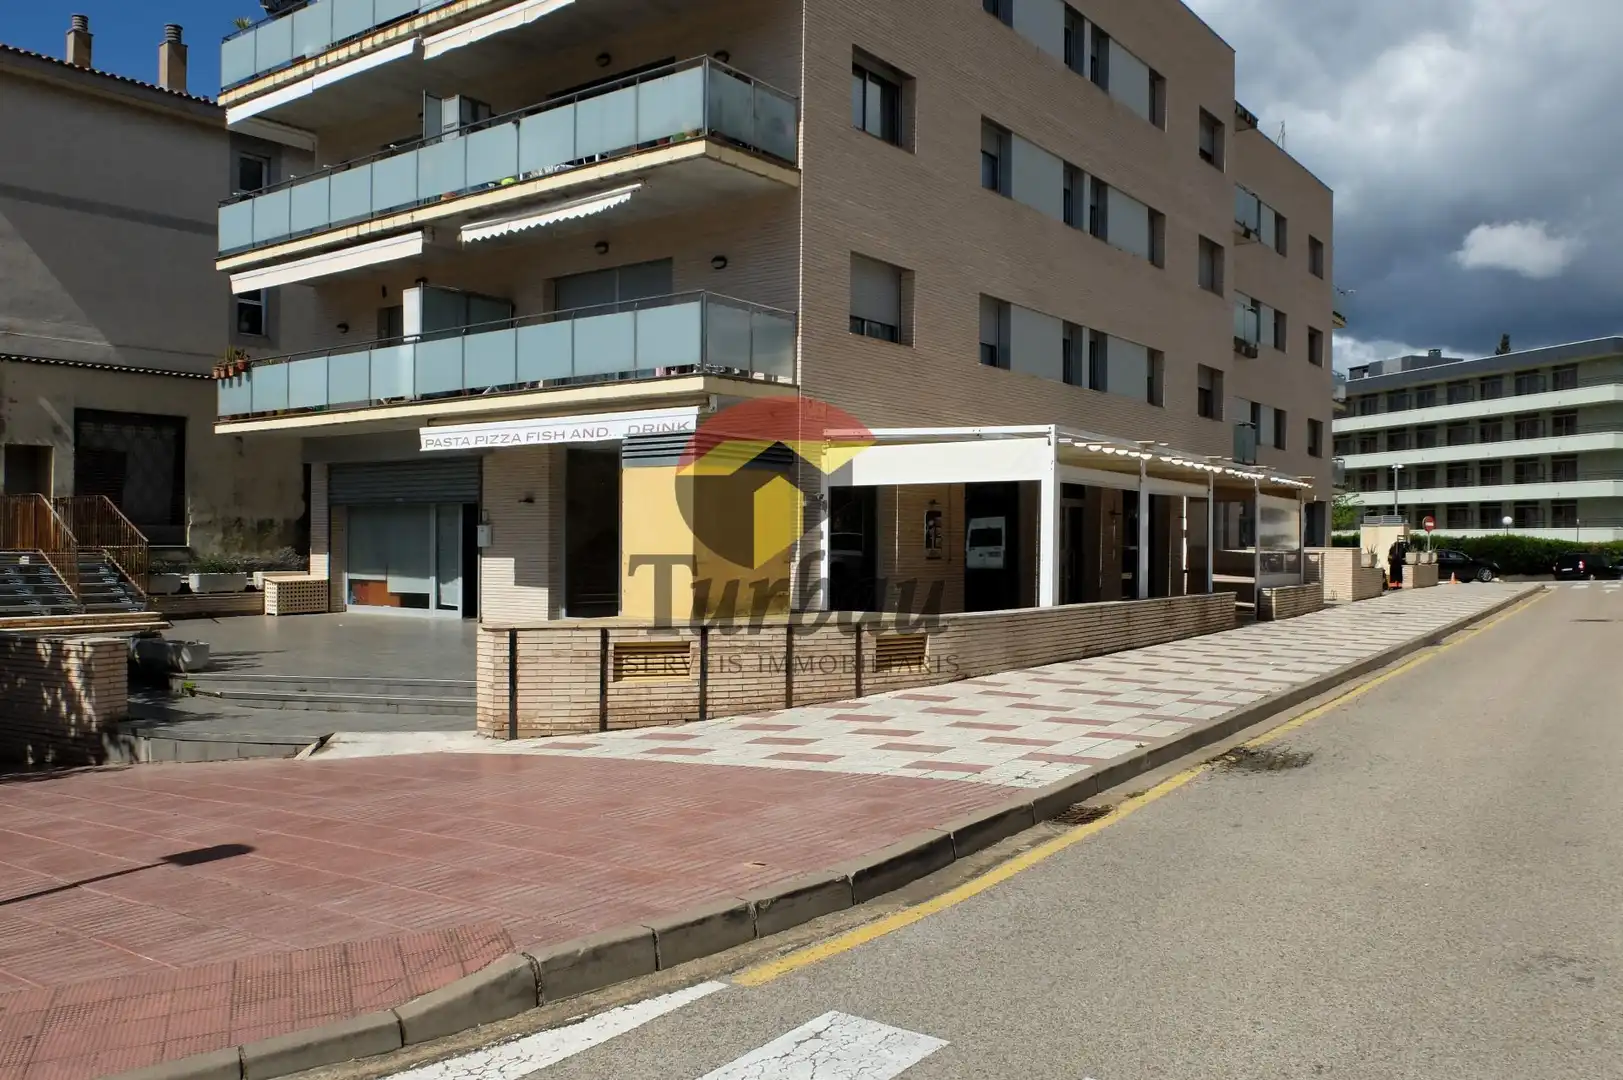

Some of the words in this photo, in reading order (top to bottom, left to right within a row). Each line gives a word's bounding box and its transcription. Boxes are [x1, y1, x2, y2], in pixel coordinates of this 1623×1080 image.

[425, 437, 470, 448] PASTA
[474, 433, 522, 445] PIZZA
[526, 430, 566, 442] FISH
[628, 420, 690, 434] DRINK
